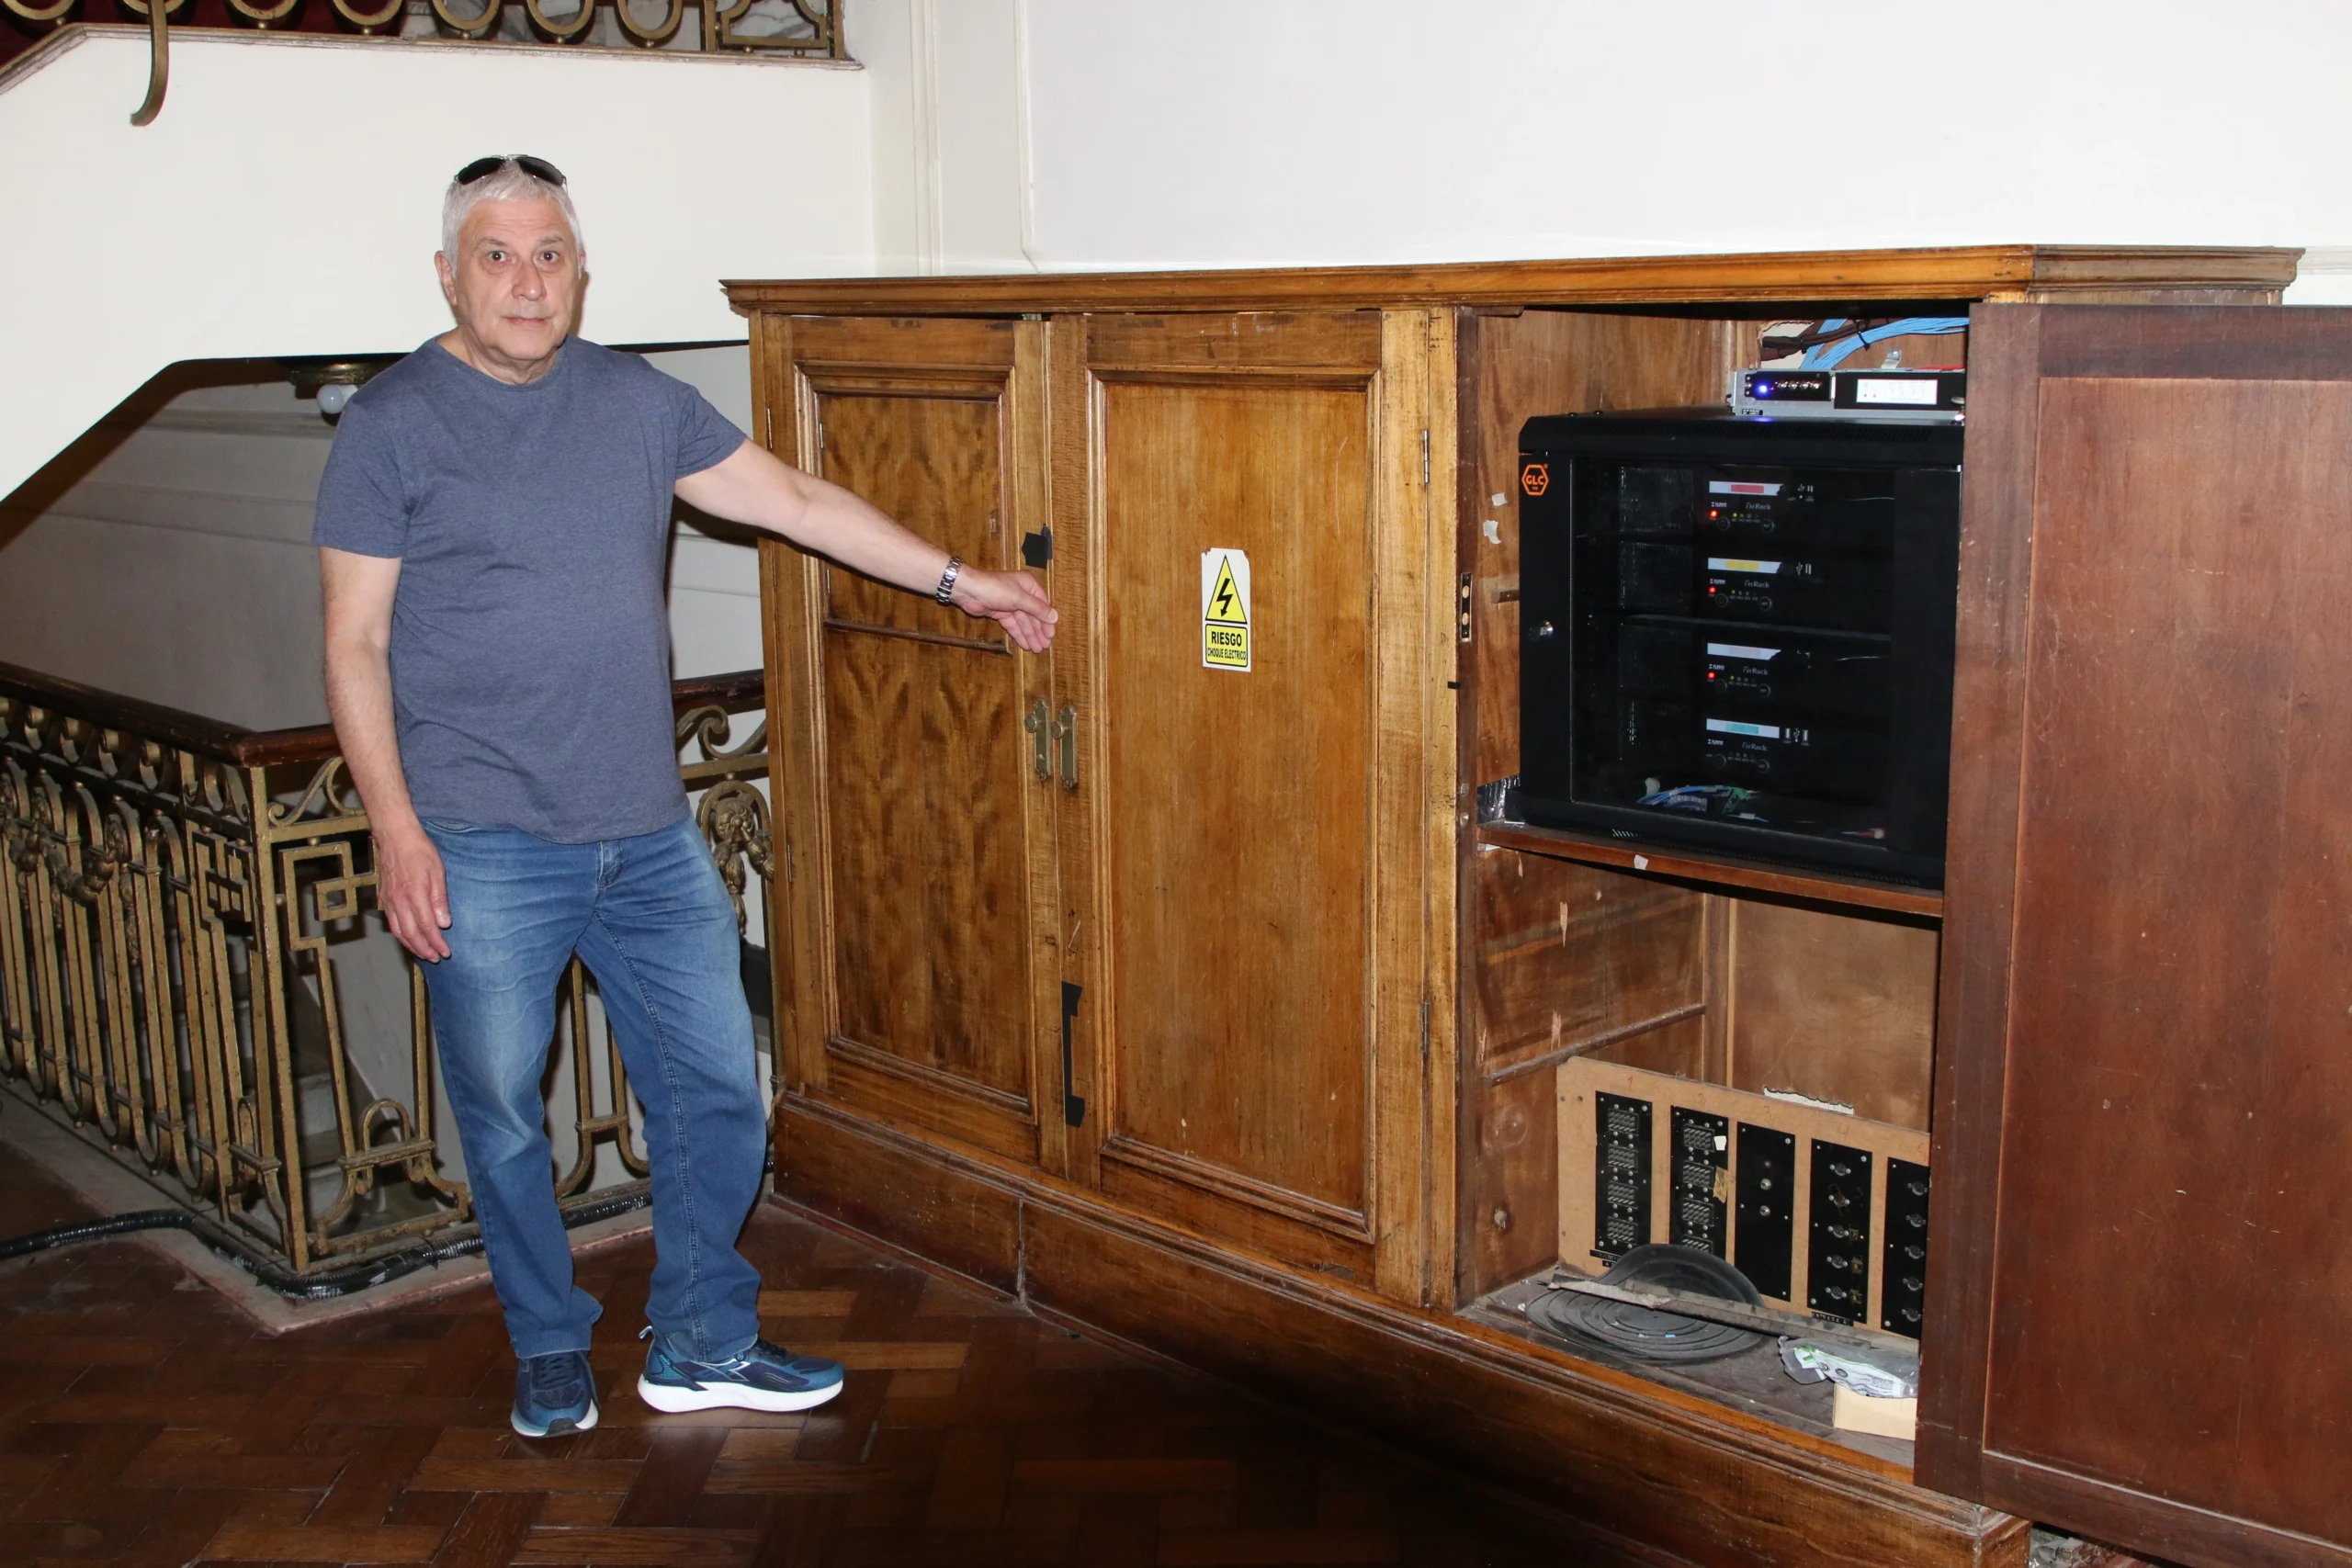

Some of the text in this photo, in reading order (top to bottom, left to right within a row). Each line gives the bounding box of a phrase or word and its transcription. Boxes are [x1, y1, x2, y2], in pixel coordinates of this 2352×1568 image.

[1525, 475, 1544, 485] GLC
[1211, 631, 1242, 647] RIESGO
[1207, 648, 1246, 660] CHOQUE ELECTRICO
